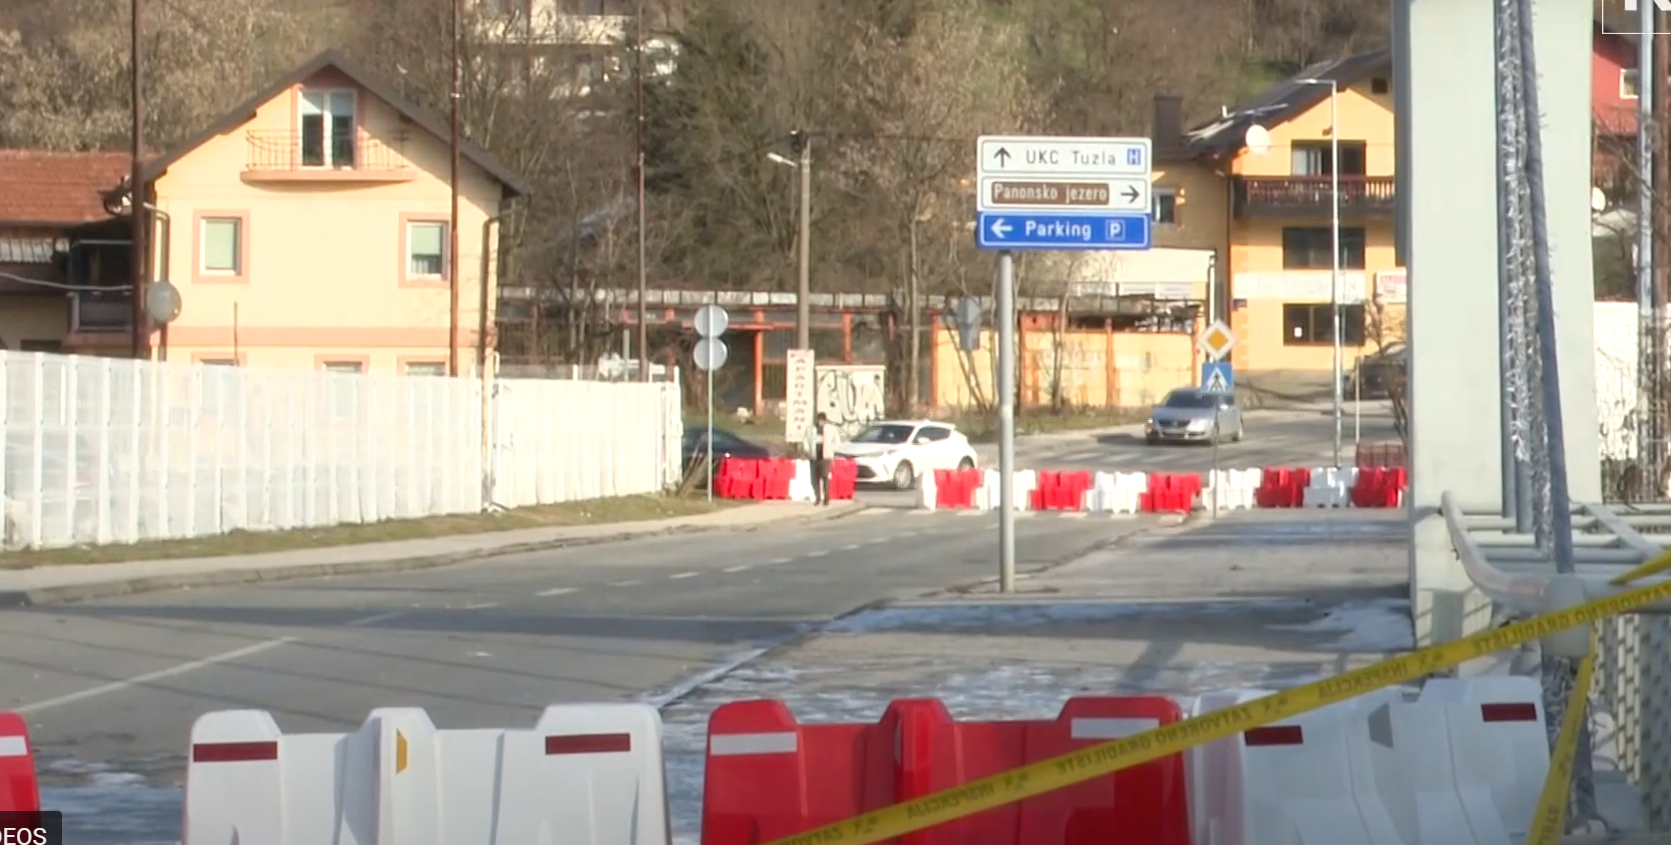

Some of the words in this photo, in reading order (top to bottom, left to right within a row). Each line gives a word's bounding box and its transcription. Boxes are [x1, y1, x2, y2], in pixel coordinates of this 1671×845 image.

[1026, 150, 1060, 165] UKC
[1072, 150, 1117, 166] Tuzla
[993, 183, 1059, 200] Panonsko
[1065, 185, 1108, 204] jezero
[1025, 220, 1092, 241] Parking
[1109, 223, 1121, 237] P
